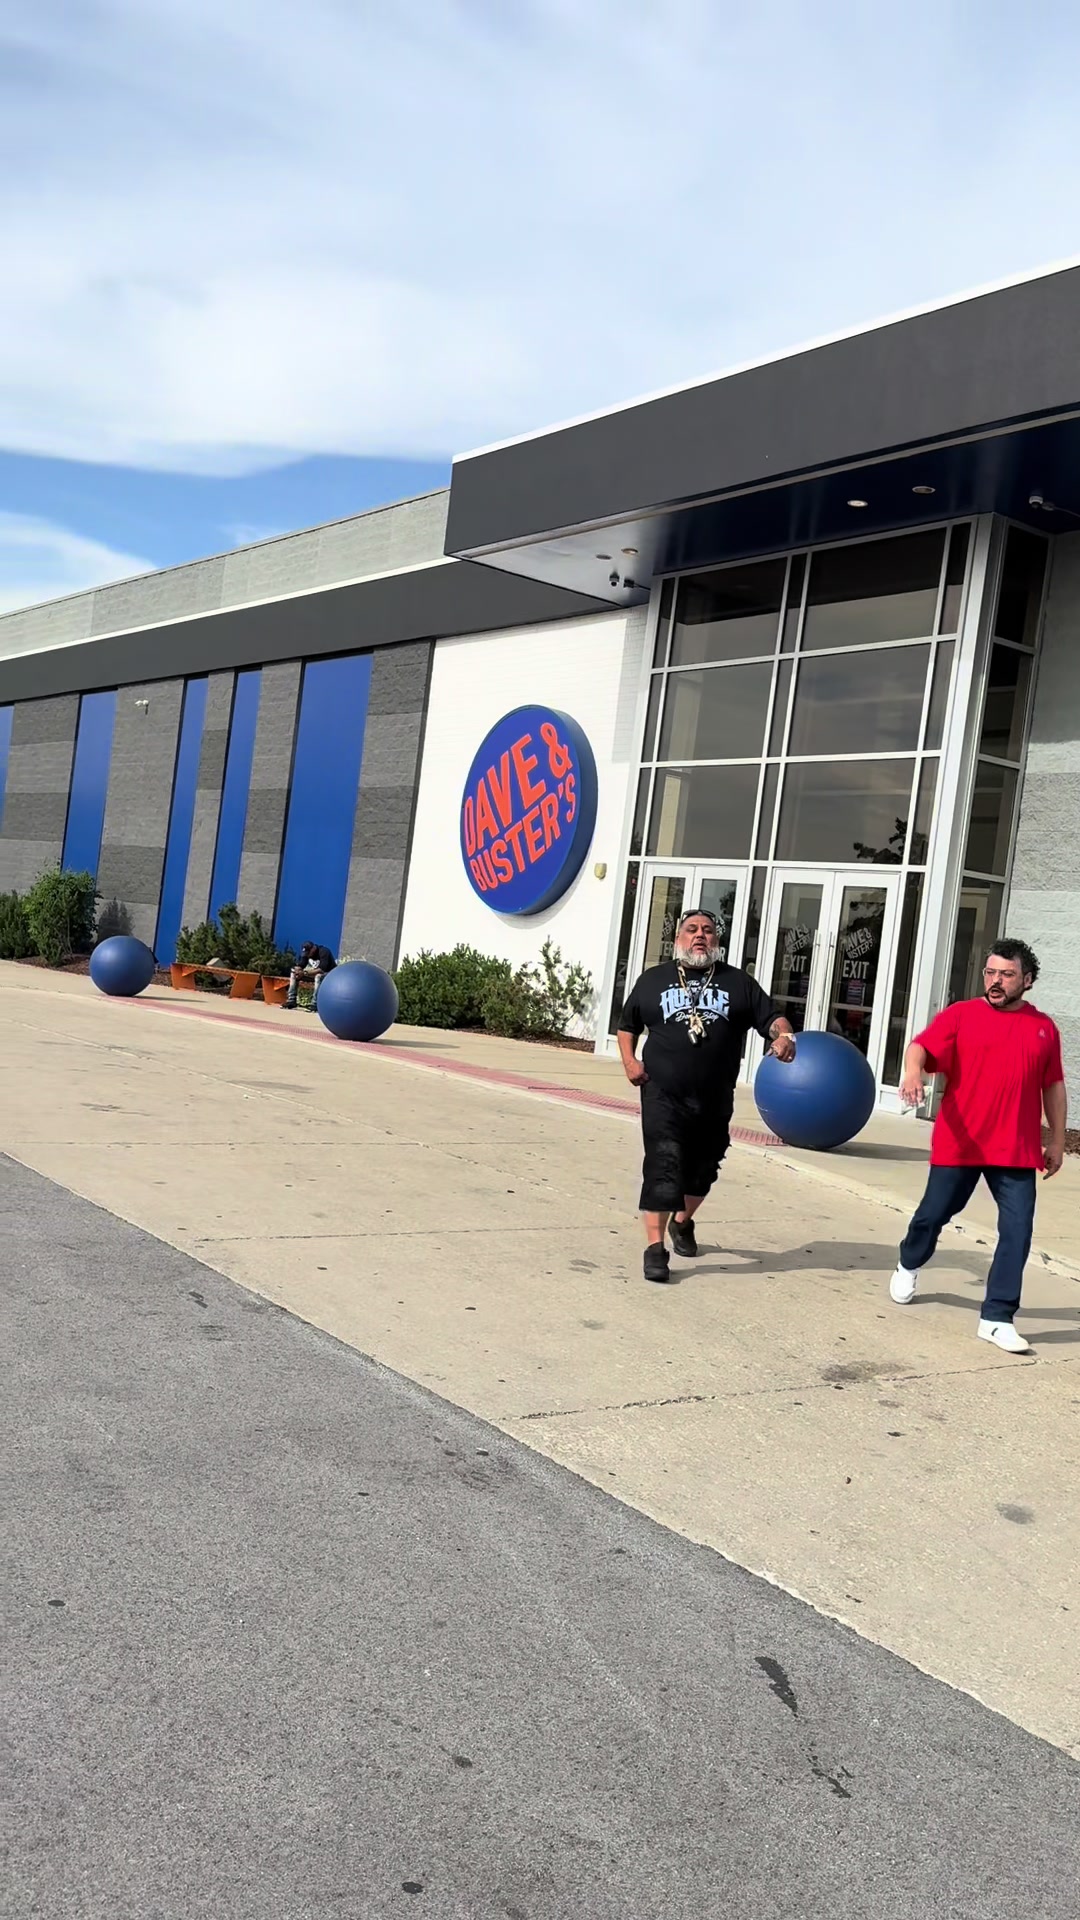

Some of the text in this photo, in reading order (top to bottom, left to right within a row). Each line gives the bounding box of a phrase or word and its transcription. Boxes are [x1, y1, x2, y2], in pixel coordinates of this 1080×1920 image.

[464, 722, 573, 857] DAVE &
[470, 773, 576, 891] BUSTER'S
[781, 954, 807, 973] EXIT
[842, 959, 870, 980] EXIT
